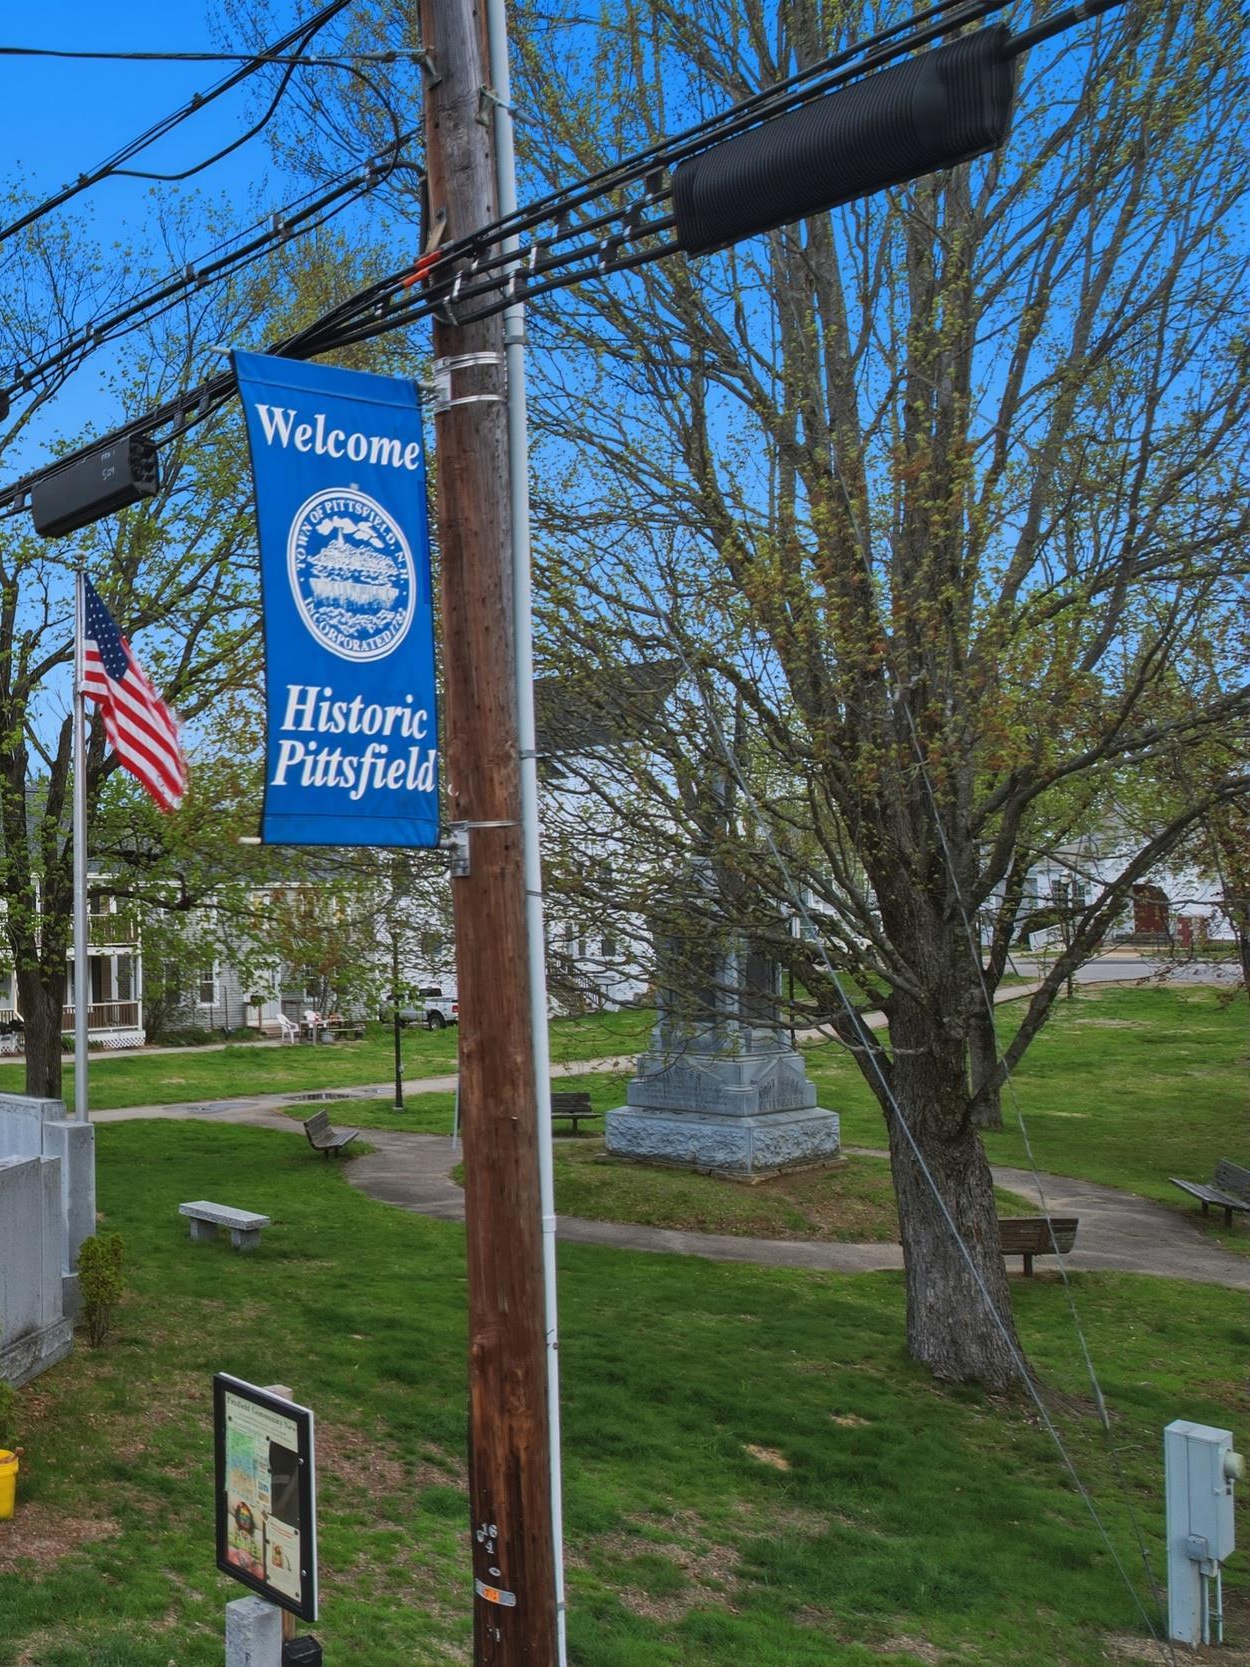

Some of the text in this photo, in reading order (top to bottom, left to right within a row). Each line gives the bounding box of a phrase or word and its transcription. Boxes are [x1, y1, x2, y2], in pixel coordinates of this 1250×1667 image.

[254, 404, 420, 471] Welcome
[295, 521, 313, 571] TOWN
[309, 506, 325, 523] OF
[304, 597, 392, 652] INCORPORATED
[280, 684, 428, 740] Historic
[270, 739, 437, 801] Pittsfield
